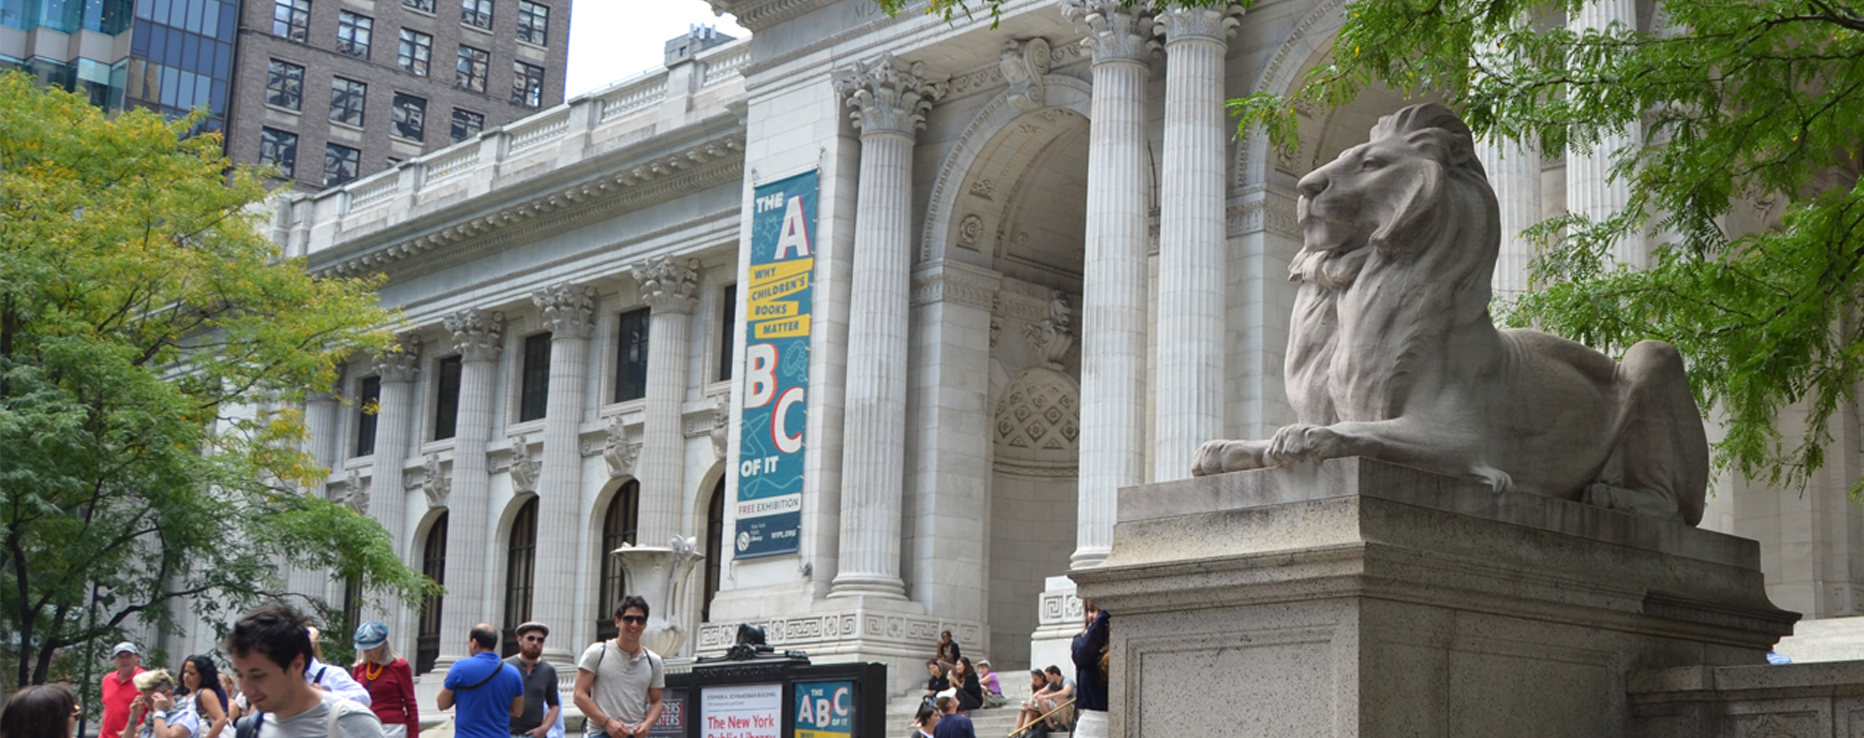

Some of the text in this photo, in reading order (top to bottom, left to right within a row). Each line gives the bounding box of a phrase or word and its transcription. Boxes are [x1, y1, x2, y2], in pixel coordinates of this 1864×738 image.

[755, 192, 784, 214] THE
[774, 195, 811, 260] A
[754, 267, 776, 280] WHY
[751, 276, 805, 301] CHILDREN'S
[754, 303, 787, 316] BOOKS
[763, 320, 799, 335] MATTER
[744, 342, 779, 409] B
[770, 386, 804, 454] C
[741, 456, 779, 477] OF IT
[738, 498, 799, 515] FREE EXHIBITION
[707, 713, 775, 730] The New York
